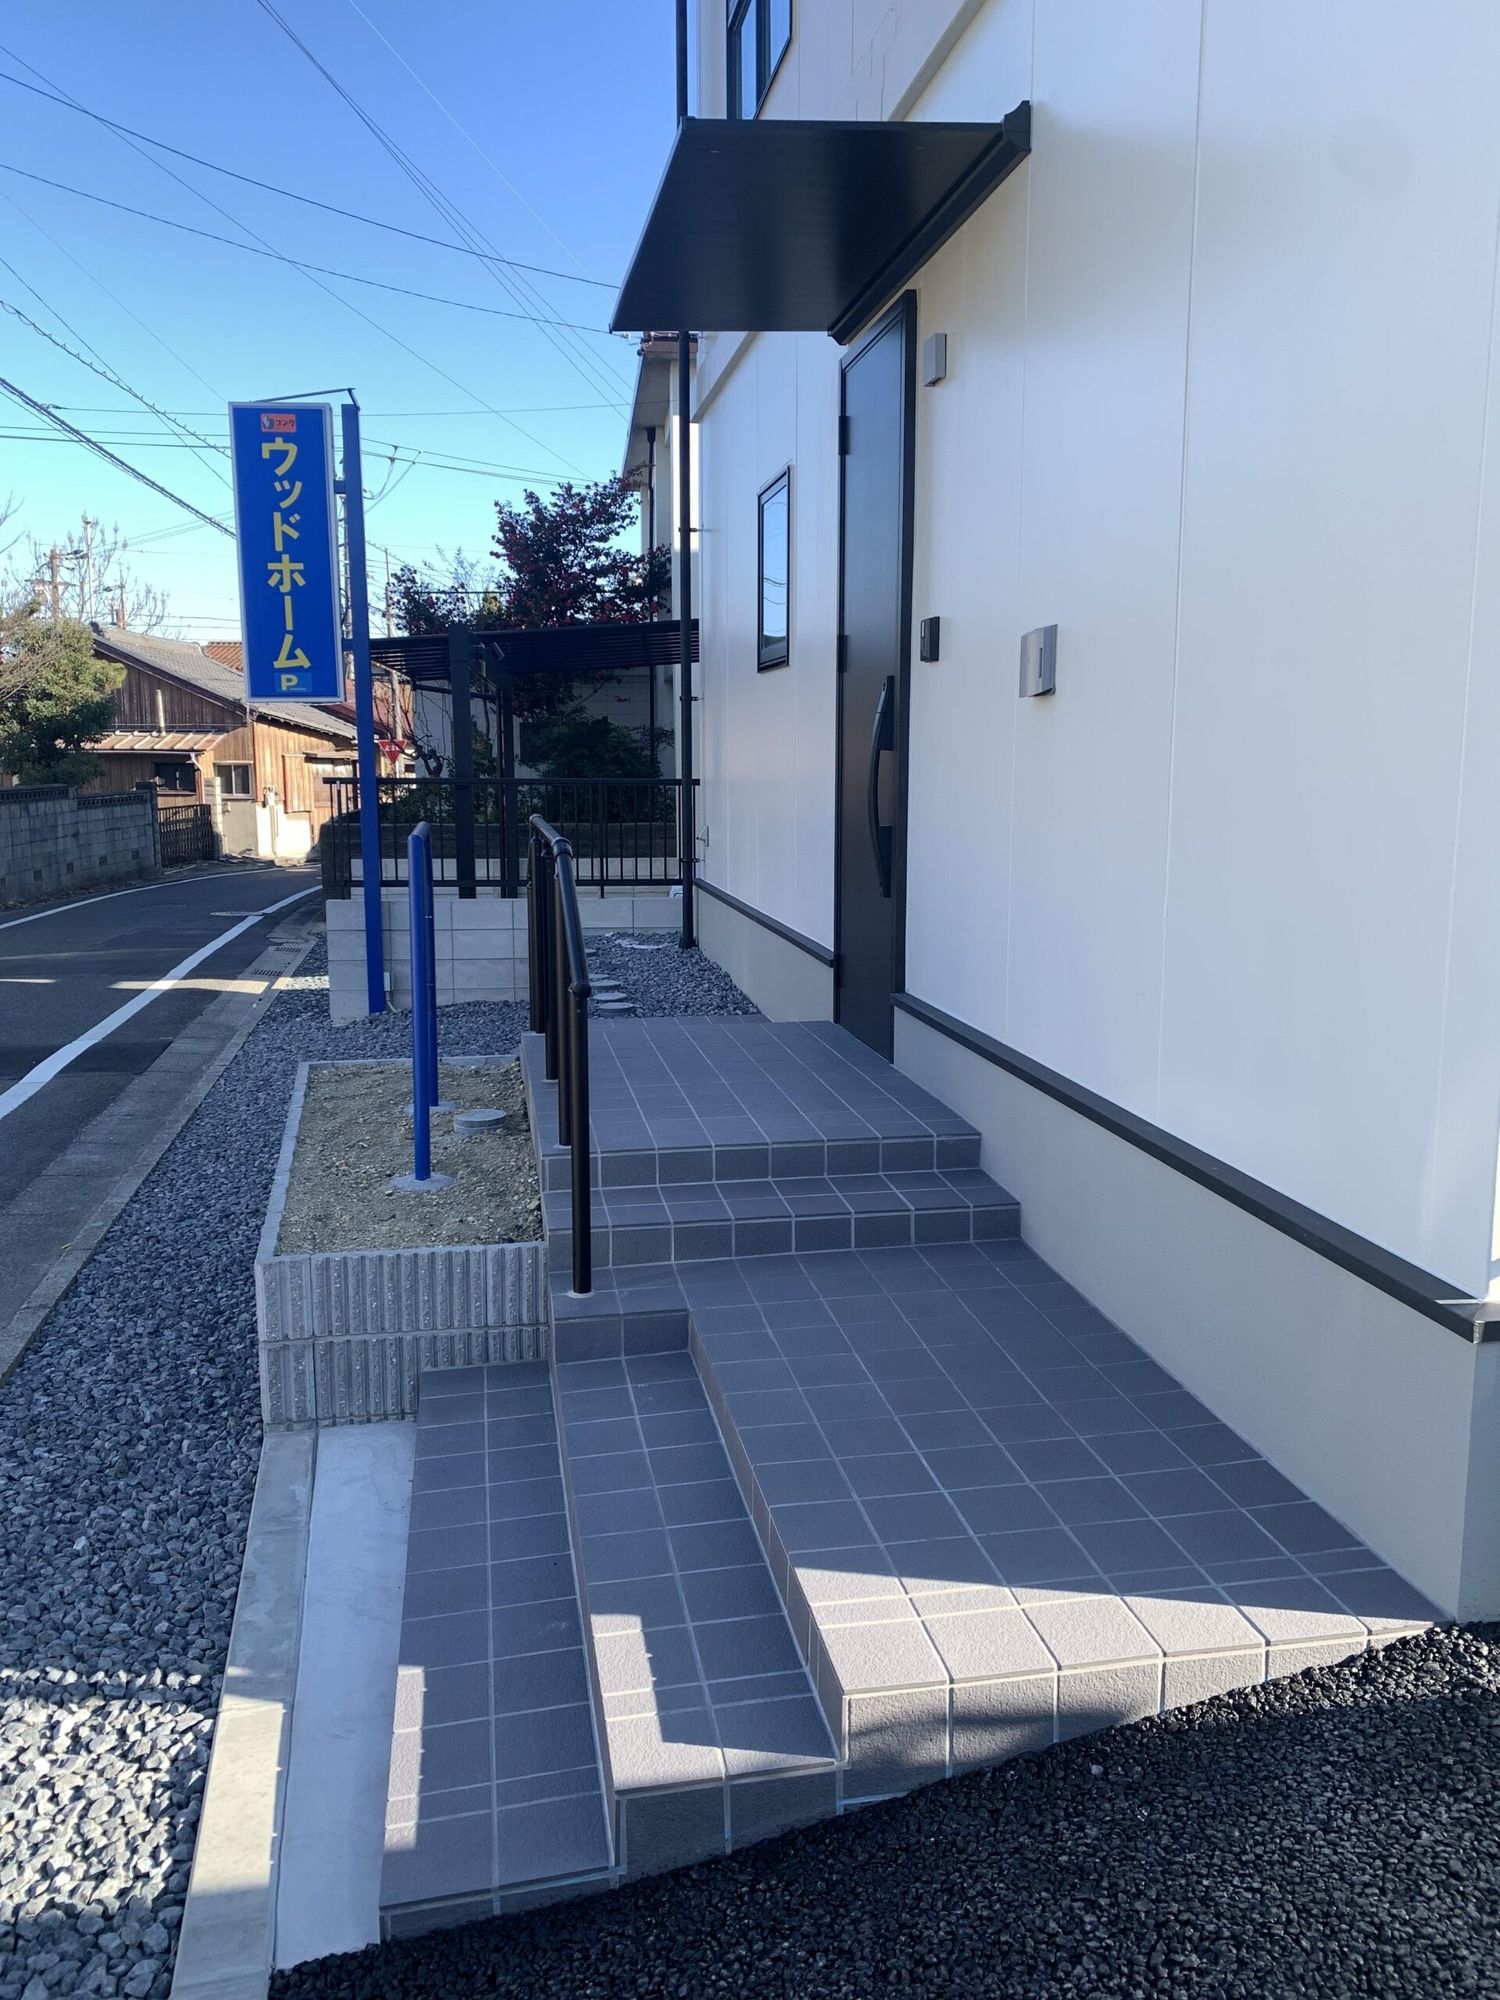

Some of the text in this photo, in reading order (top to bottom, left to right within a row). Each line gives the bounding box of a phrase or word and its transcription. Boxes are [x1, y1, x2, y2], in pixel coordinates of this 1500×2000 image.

[261, 437, 312, 669] ウッドホーム
[280, 674, 298, 691] P
